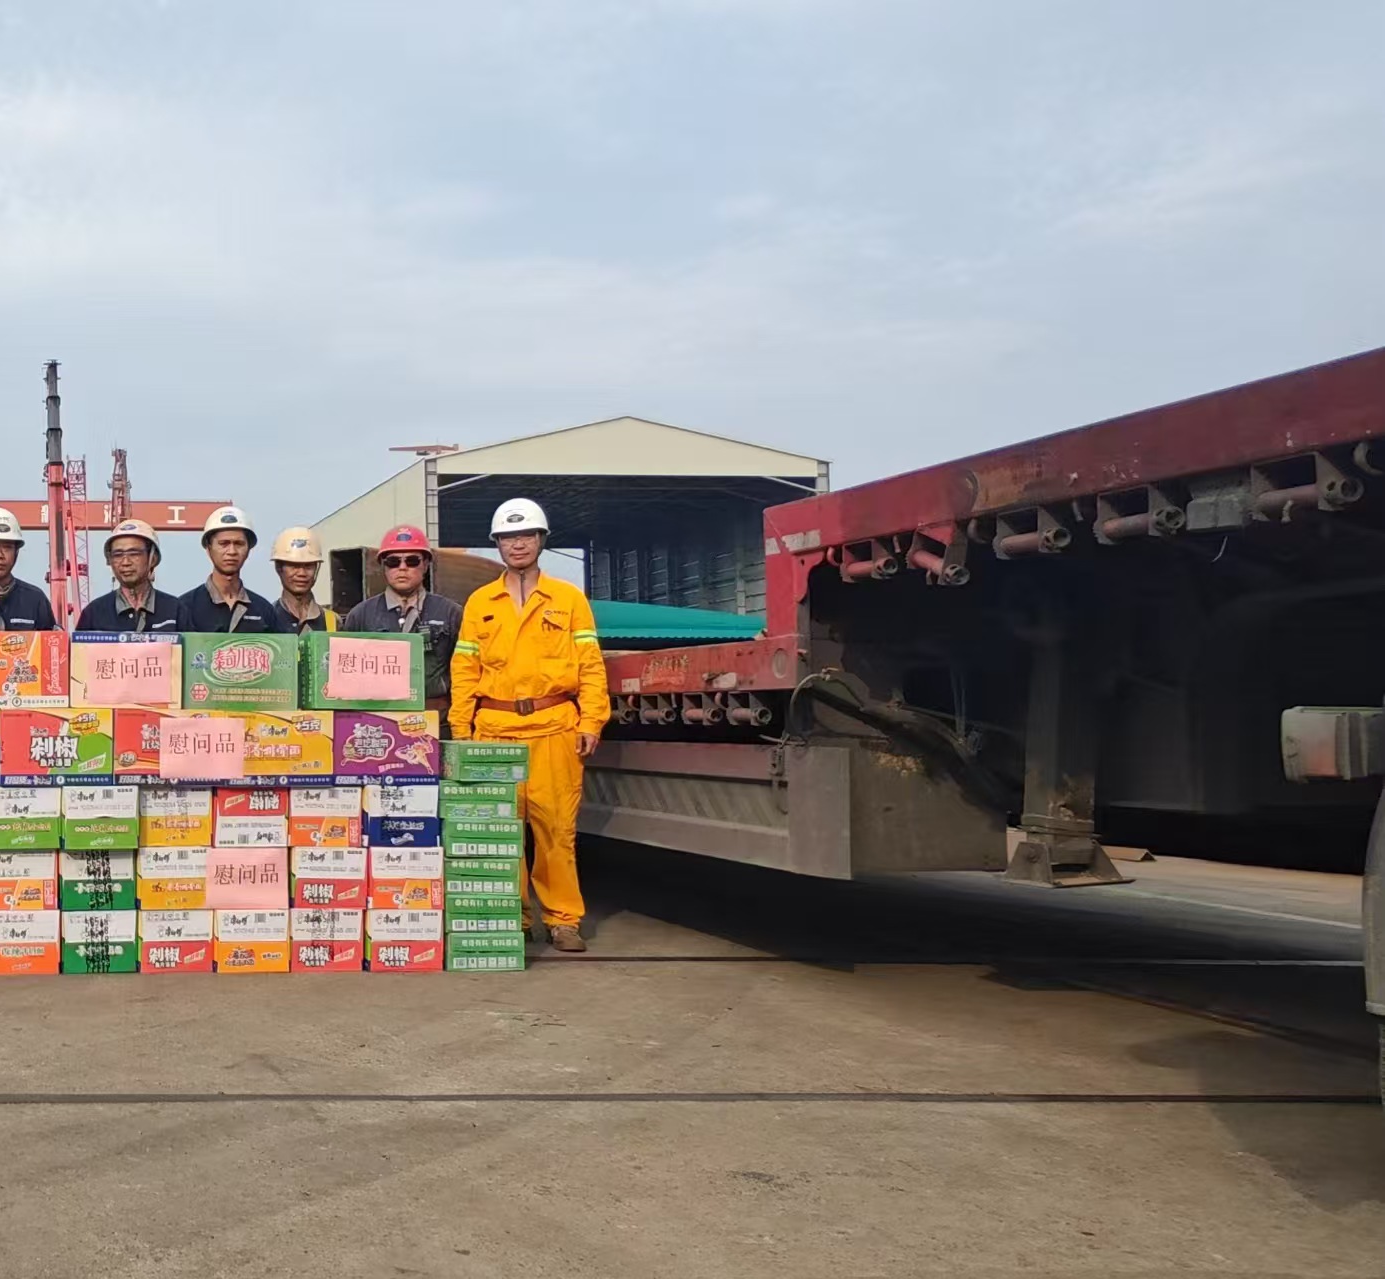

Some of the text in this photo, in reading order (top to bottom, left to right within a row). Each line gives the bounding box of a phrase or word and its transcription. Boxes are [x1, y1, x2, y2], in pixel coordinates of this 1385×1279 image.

[95, 656, 163, 681] 慰问品
[337, 652, 402, 676] 慰问品
[296, 720, 320, 731] +5克
[30, 736, 78, 760] 剁椒
[169, 732, 236, 756] 慰问品
[215, 863, 279, 886] 慰问品
